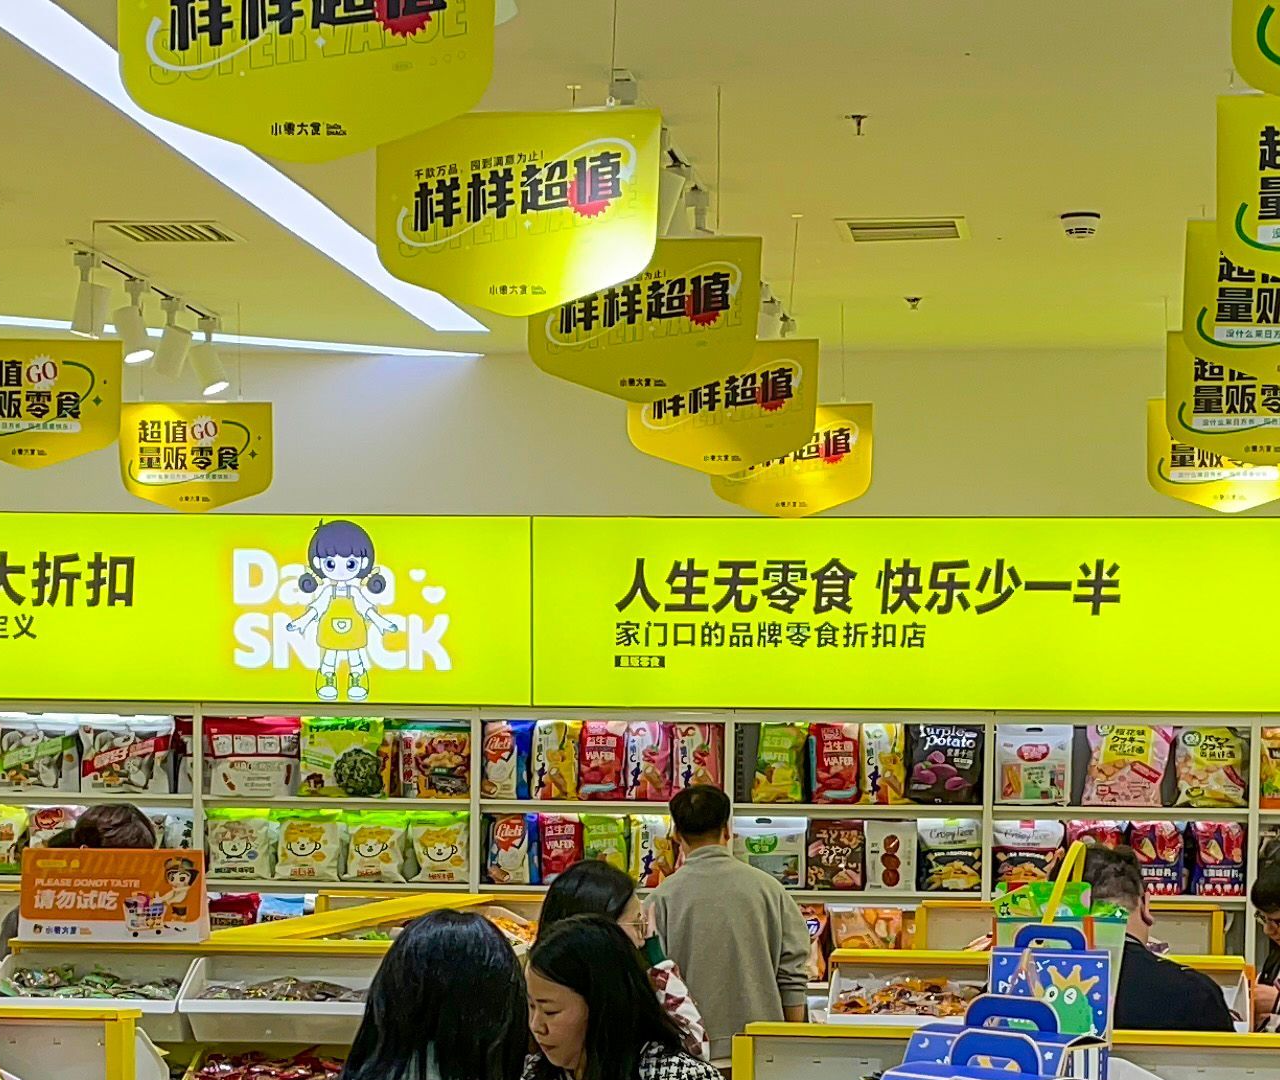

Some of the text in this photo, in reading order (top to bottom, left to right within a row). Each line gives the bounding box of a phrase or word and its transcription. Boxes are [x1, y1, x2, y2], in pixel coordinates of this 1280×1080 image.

[413, 151, 622, 232] 样样超值
[25, 361, 58, 384] GO
[138, 420, 219, 443] 超值 GO
[138, 446, 240, 471] 量贩零食
[615, 557, 1121, 616] 人生无零食 快乐少一半
[233, 611, 453, 671] SNCK
[615, 621, 928, 649] 家门口的品牌零食折扣店
[34, 878, 141, 889] PLEASE DONOT TASTE
[33, 889, 120, 911] 请勿试吃
